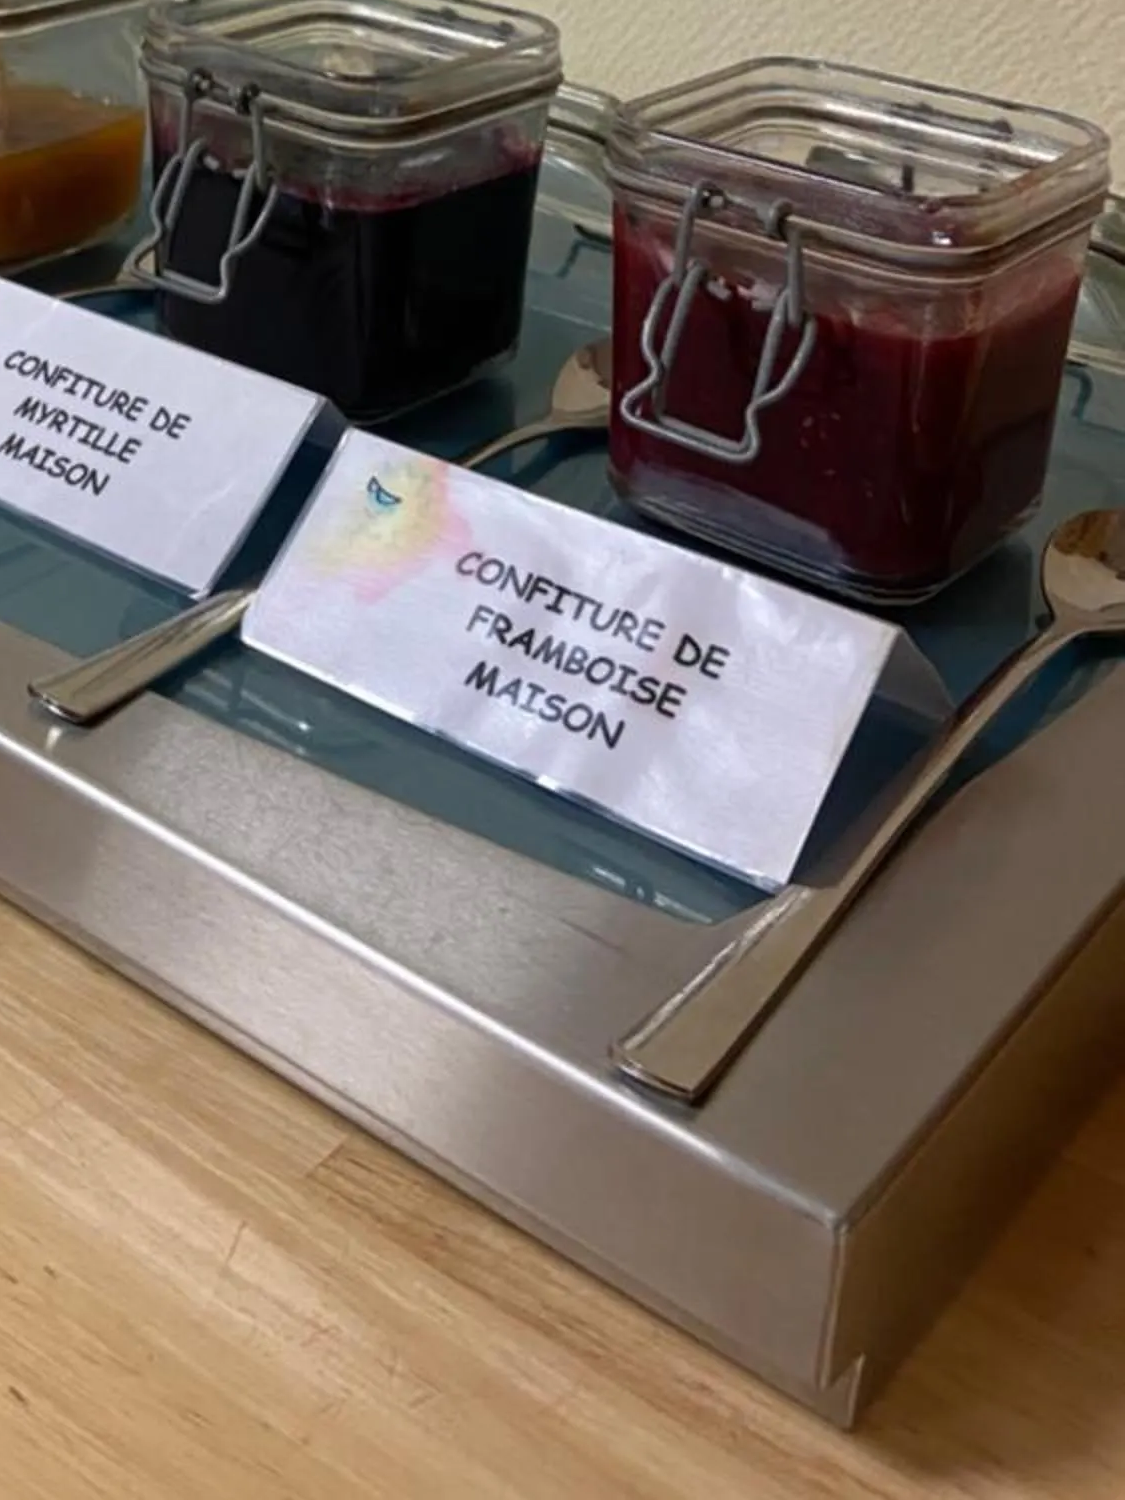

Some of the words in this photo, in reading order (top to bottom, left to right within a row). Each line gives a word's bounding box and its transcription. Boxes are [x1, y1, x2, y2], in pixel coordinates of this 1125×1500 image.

[3, 349, 150, 422] CONFITURE
[151, 405, 192, 441] DE
[13, 395, 143, 464] MYRTILLE
[455, 550, 667, 652] CONFITURE
[672, 632, 732, 681] DE
[463, 604, 689, 720] FRAMBOISE
[463, 659, 627, 751] MAISON
